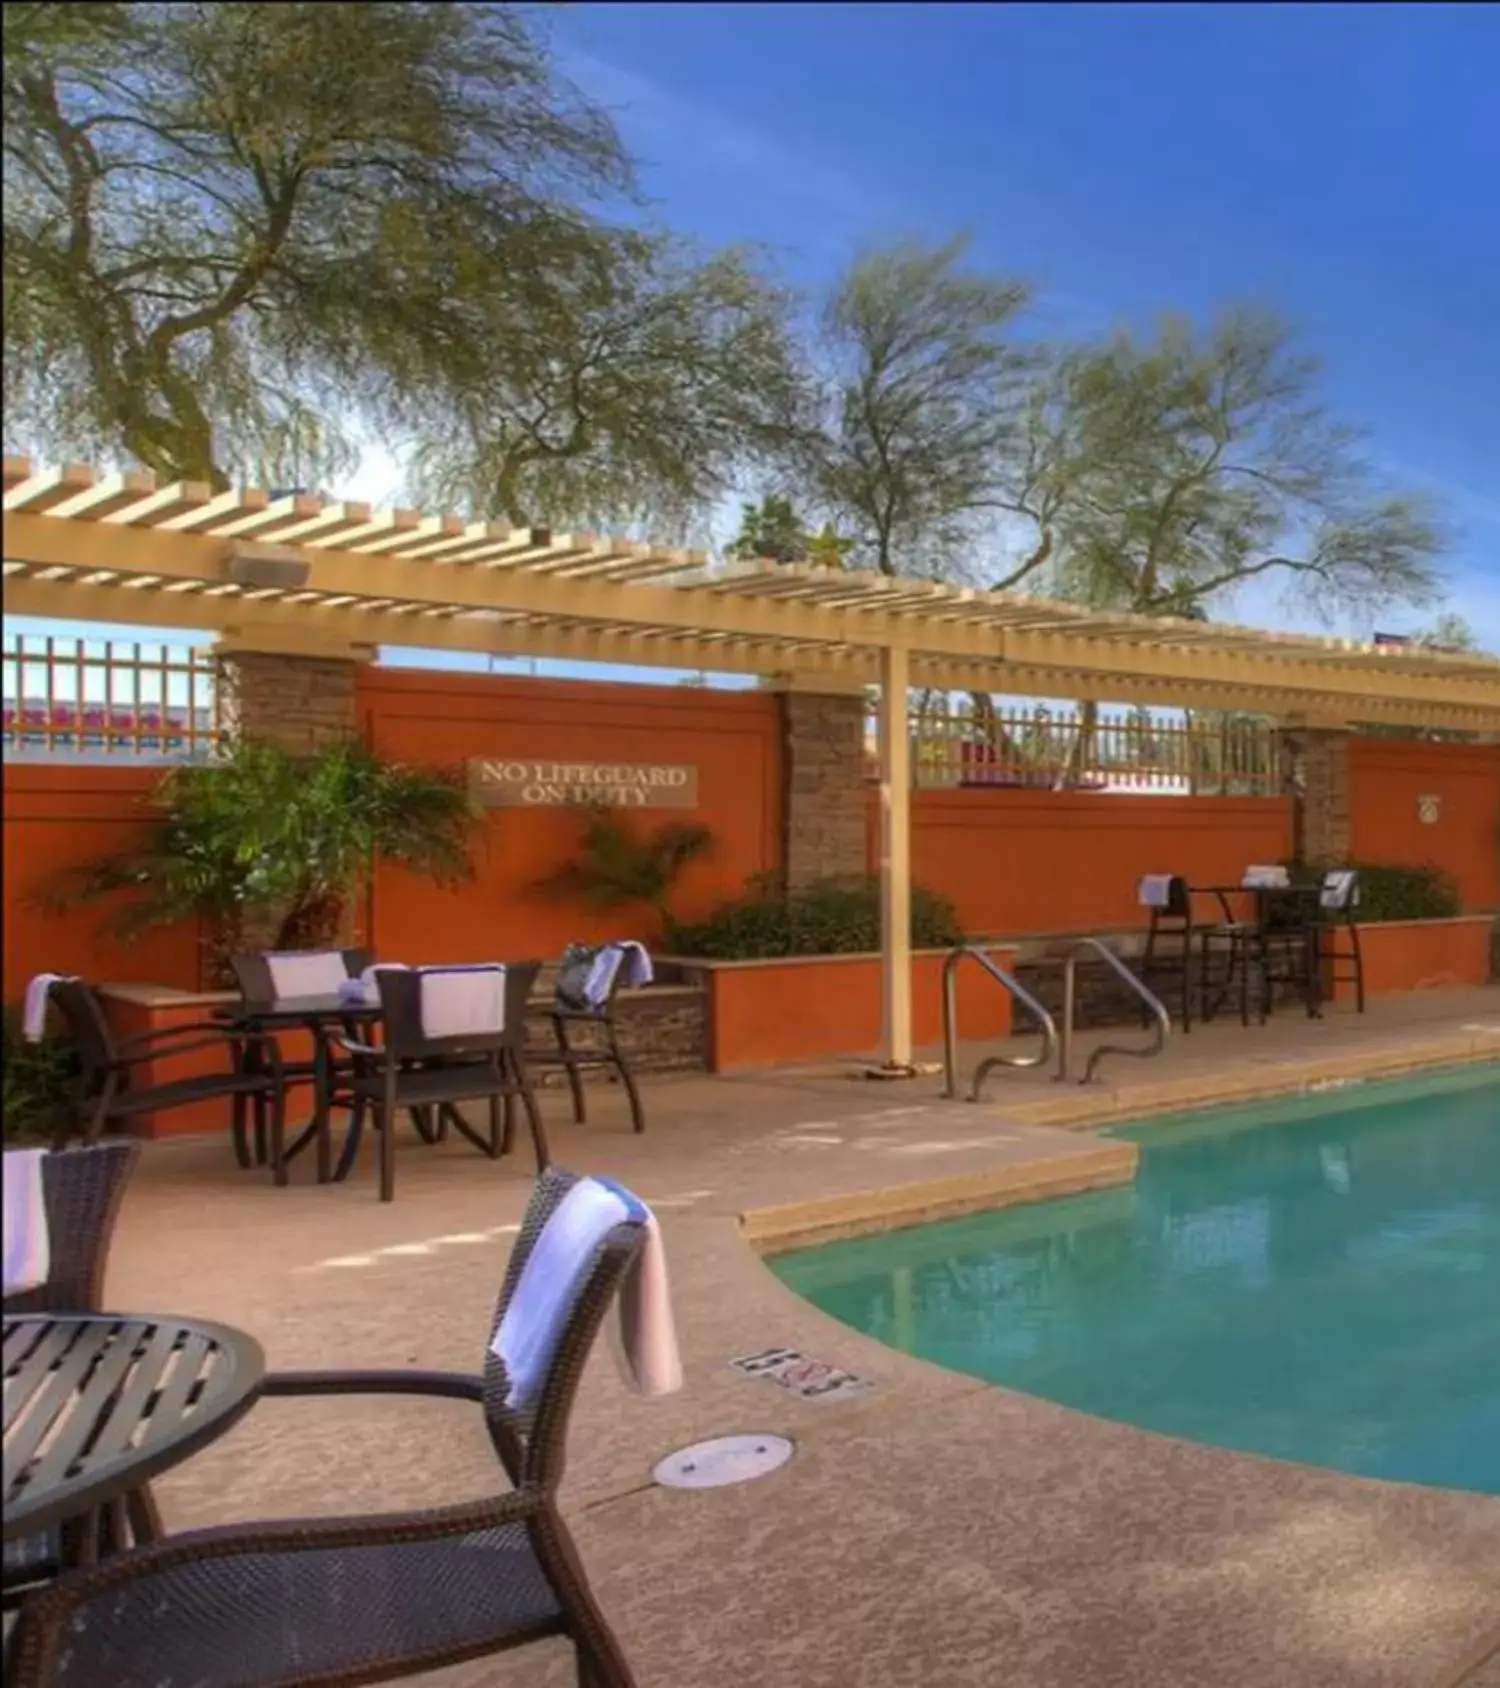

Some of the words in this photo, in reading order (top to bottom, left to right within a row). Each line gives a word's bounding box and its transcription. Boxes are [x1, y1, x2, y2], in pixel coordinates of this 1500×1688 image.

[481, 762, 528, 783] NO
[534, 764, 688, 787] LIFEGUARD
[521, 784, 567, 804] ON
